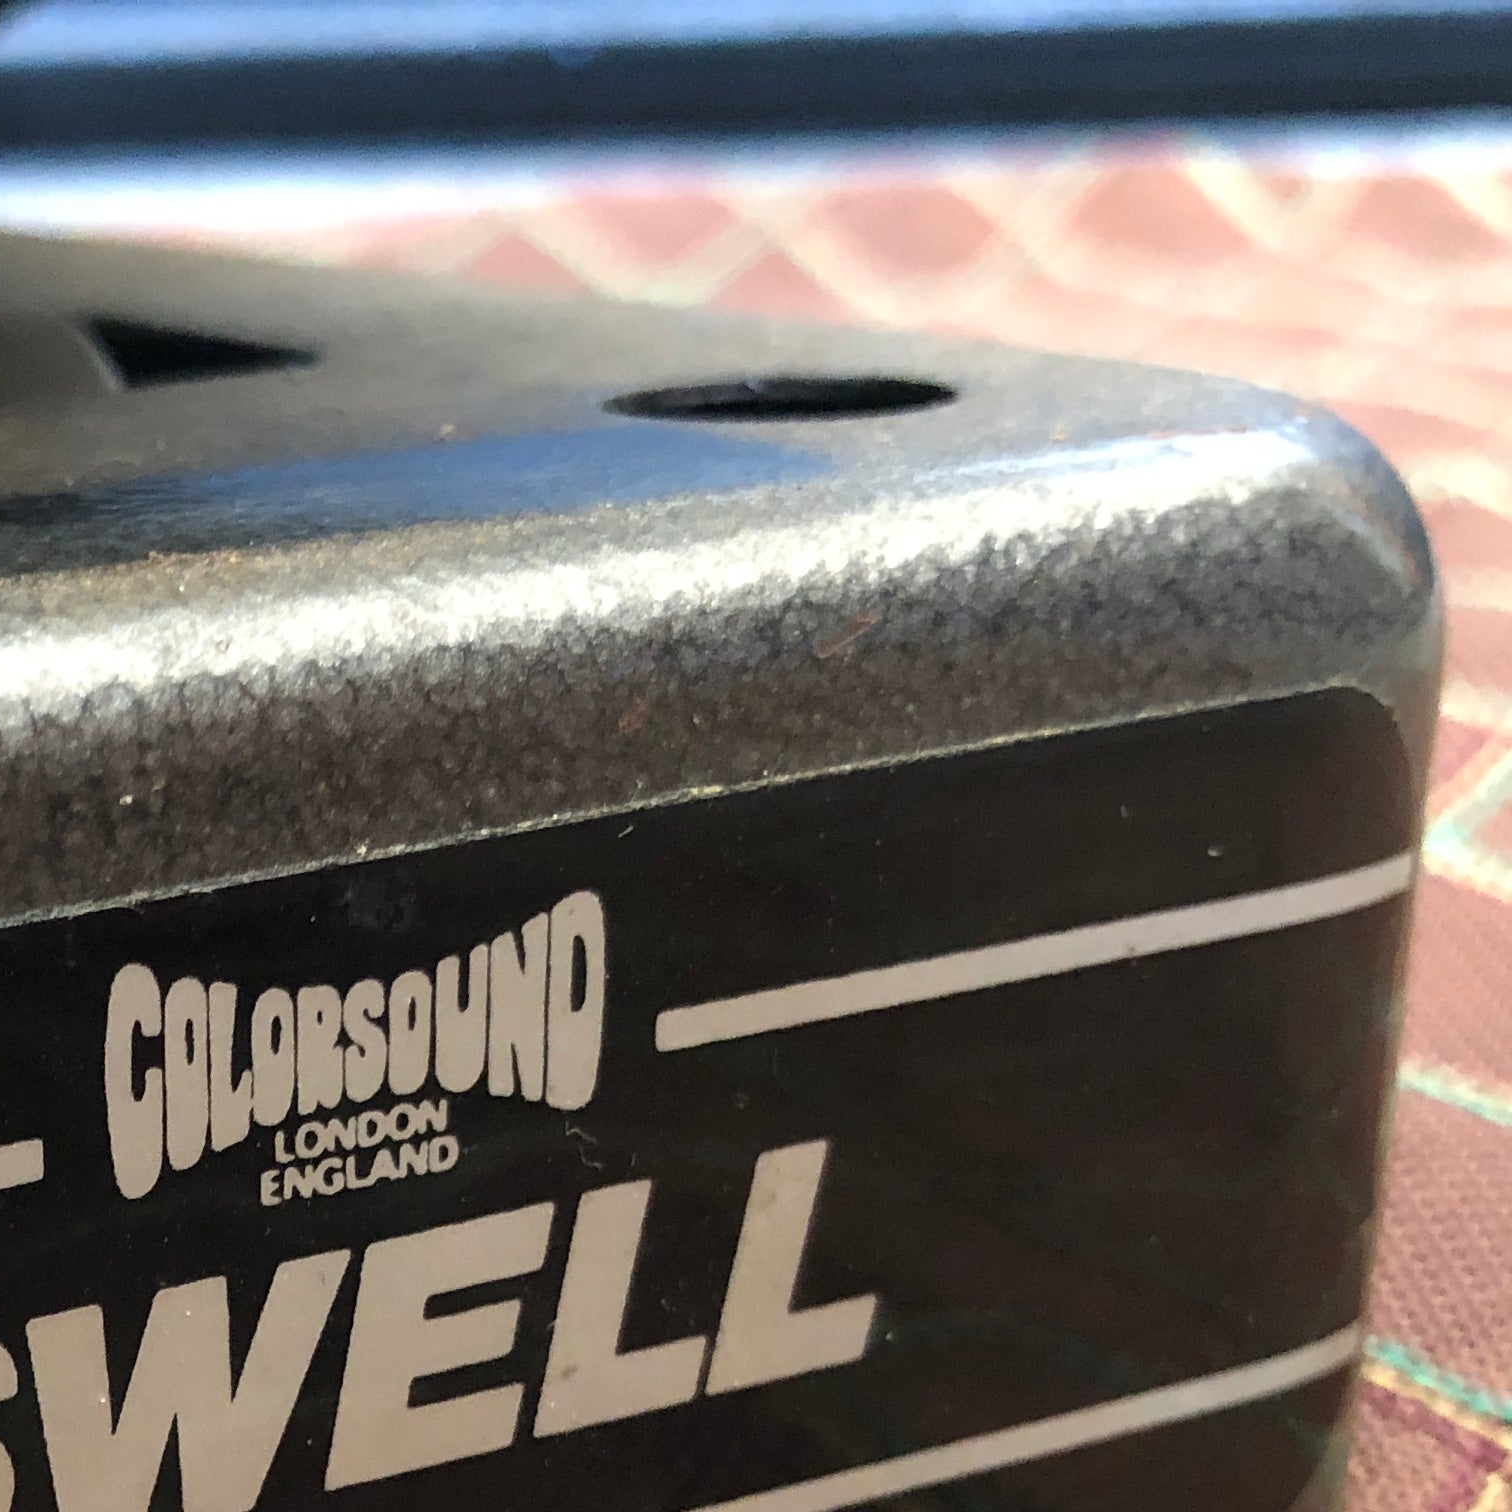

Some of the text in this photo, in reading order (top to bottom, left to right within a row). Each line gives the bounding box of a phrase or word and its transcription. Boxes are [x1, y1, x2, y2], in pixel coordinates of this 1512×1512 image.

[103, 890, 606, 1200] COLORSOUND
[274, 1099, 448, 1164] LONDON
[260, 1135, 460, 1206] ENGLAND
